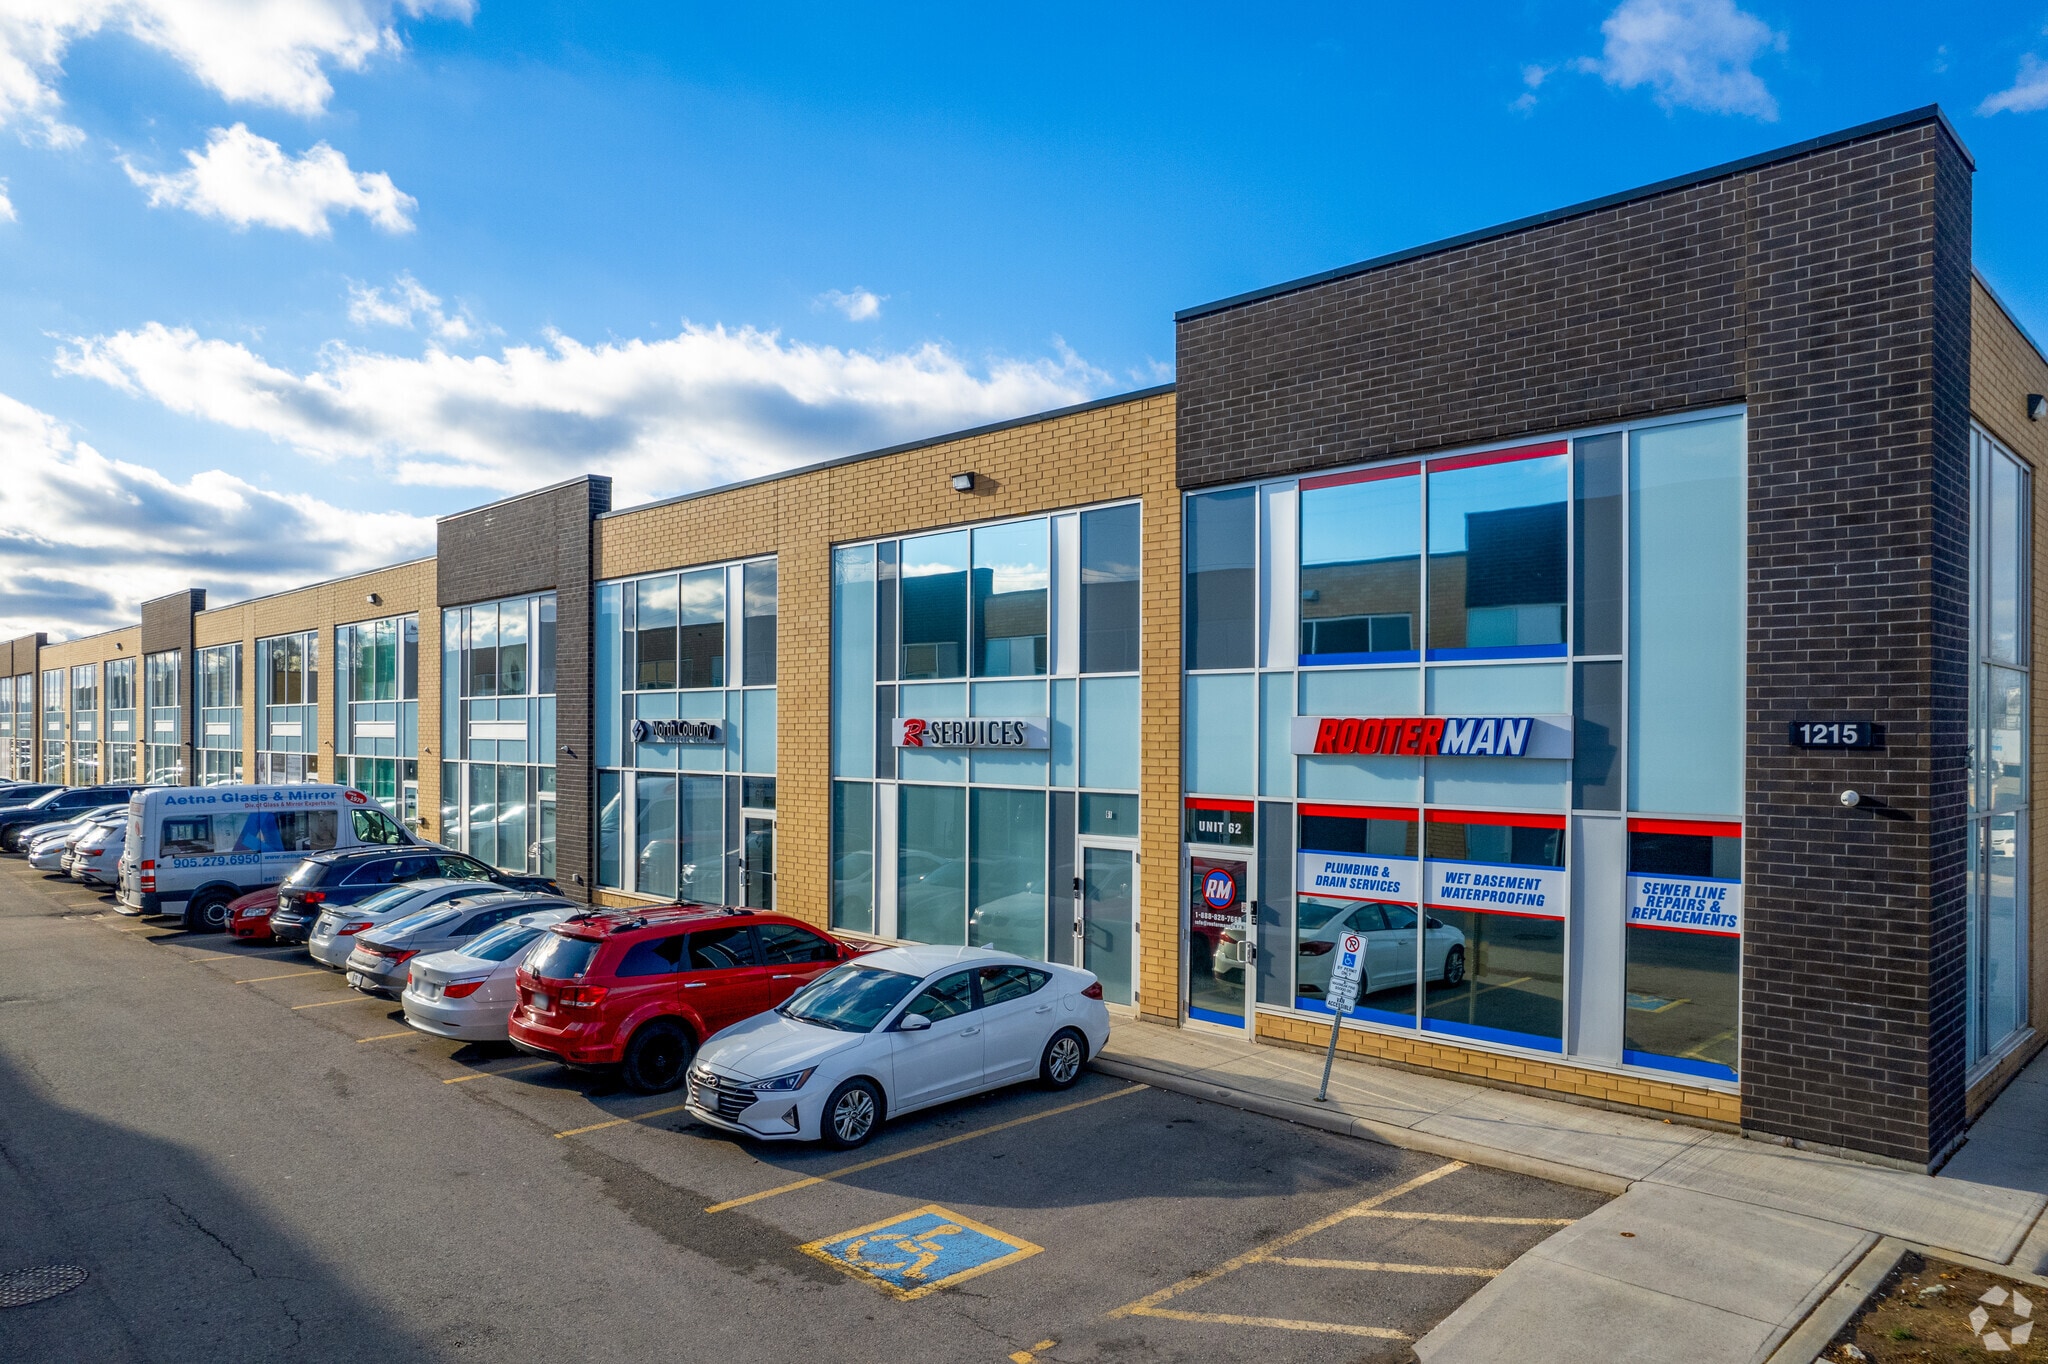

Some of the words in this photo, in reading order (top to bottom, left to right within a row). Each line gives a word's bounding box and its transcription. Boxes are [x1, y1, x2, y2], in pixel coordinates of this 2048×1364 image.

[652, 720, 676, 736] North
[677, 721, 713, 739] Country
[1800, 724, 1858, 744] 1215
[165, 795, 217, 806] Aetna
[221, 793, 268, 803] Glass
[273, 791, 283, 801] &
[288, 790, 337, 801] Mirror
[1198, 820, 1224, 833] UNIT
[1228, 823, 1242, 835] 62
[173, 853, 260, 868] 905.279.6950
[1324, 861, 1379, 877] PLUMBING
[1381, 866, 1390, 878] &
[1205, 879, 1232, 899] RM
[1315, 874, 1348, 889] DRAIN
[1349, 877, 1401, 893] SERVICES
[1444, 871, 1472, 886] WET
[1473, 873, 1543, 891] BASEMENT
[1642, 881, 1692, 897] SEWER
[1694, 885, 1727, 900] LINE
[1440, 885, 1546, 907] WATERPROOFING
[1645, 895, 1706, 912] REPAIRS
[1709, 900, 1721, 913] &
[1631, 906, 1738, 928] REPLACEMENTS
